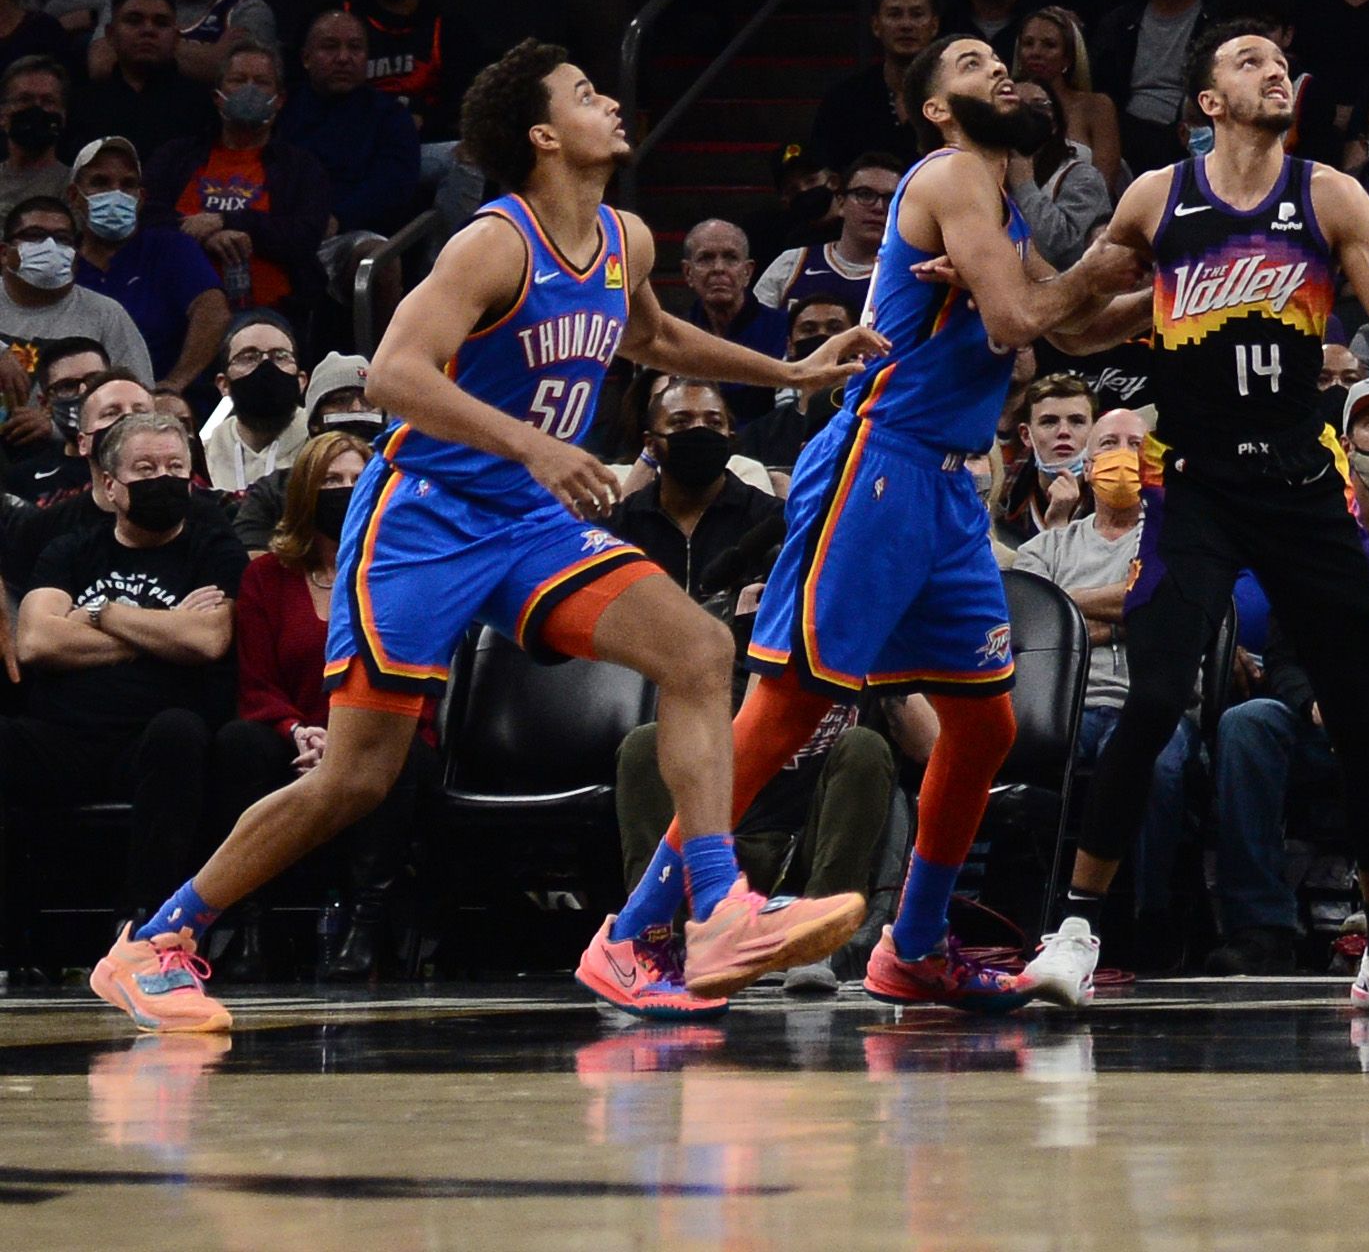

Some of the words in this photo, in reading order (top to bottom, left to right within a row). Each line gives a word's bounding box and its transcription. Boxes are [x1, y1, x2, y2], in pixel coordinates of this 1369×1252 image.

[205, 195, 247, 211] PHX
[1271, 220, 1303, 231] PayPal
[1170, 254, 1309, 321] Valley
[1202, 264, 1230, 279] THE
[1235, 343, 1282, 396] 14
[528, 379, 592, 440] 50
[73, 579, 144, 609] AKATOMI
[147, 586, 178, 611] PLA
